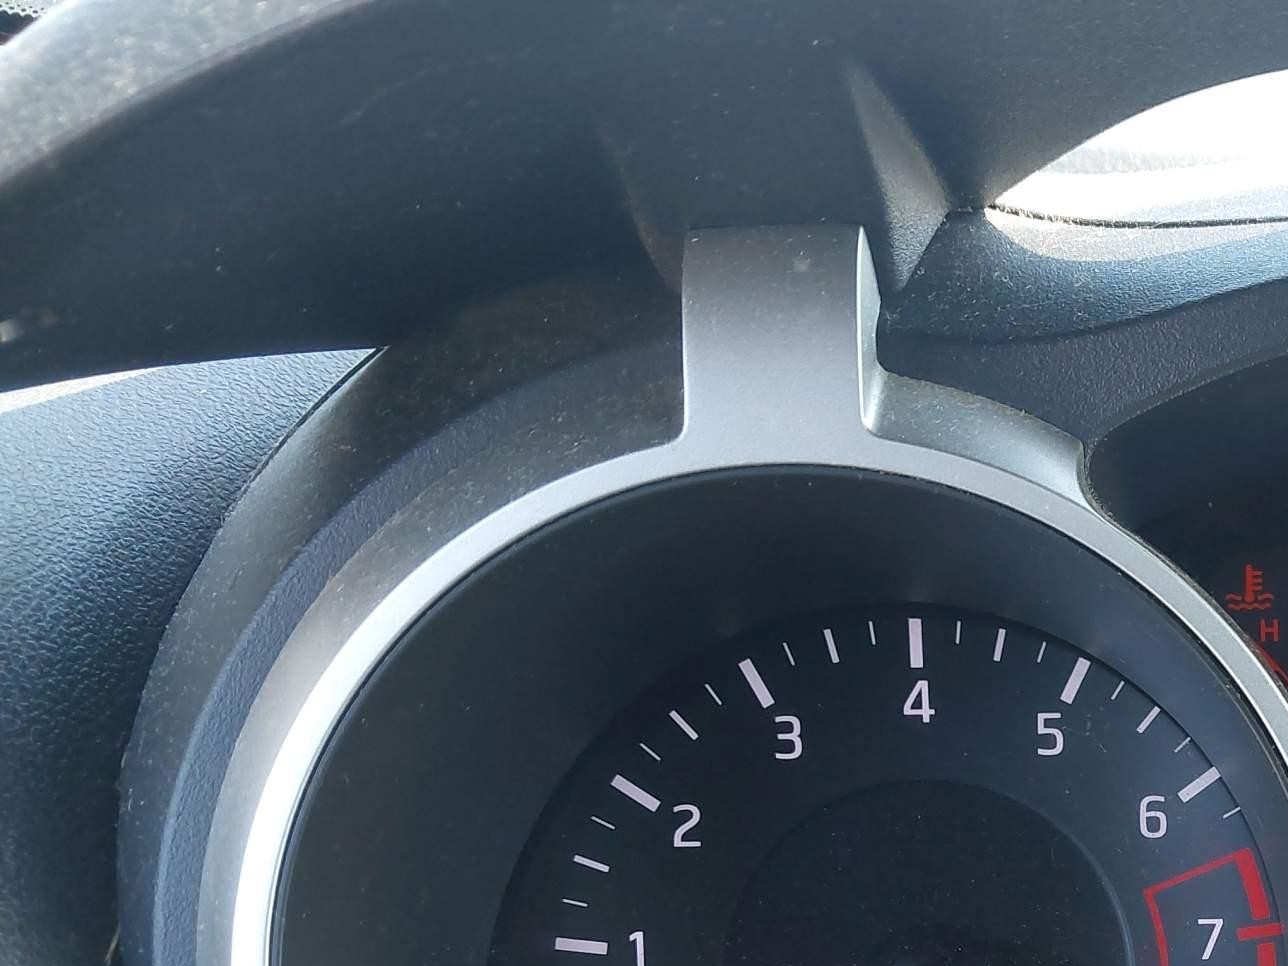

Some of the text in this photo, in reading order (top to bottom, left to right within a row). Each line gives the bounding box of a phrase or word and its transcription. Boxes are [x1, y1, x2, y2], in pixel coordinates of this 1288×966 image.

[1261, 620, 1278, 641] H
[904, 680, 935, 722] 4
[775, 716, 802, 759] 3
[1038, 713, 1063, 755] 5
[674, 805, 701, 847] 2
[1140, 796, 1166, 838] 6
[1198, 919, 1223, 959] 7
